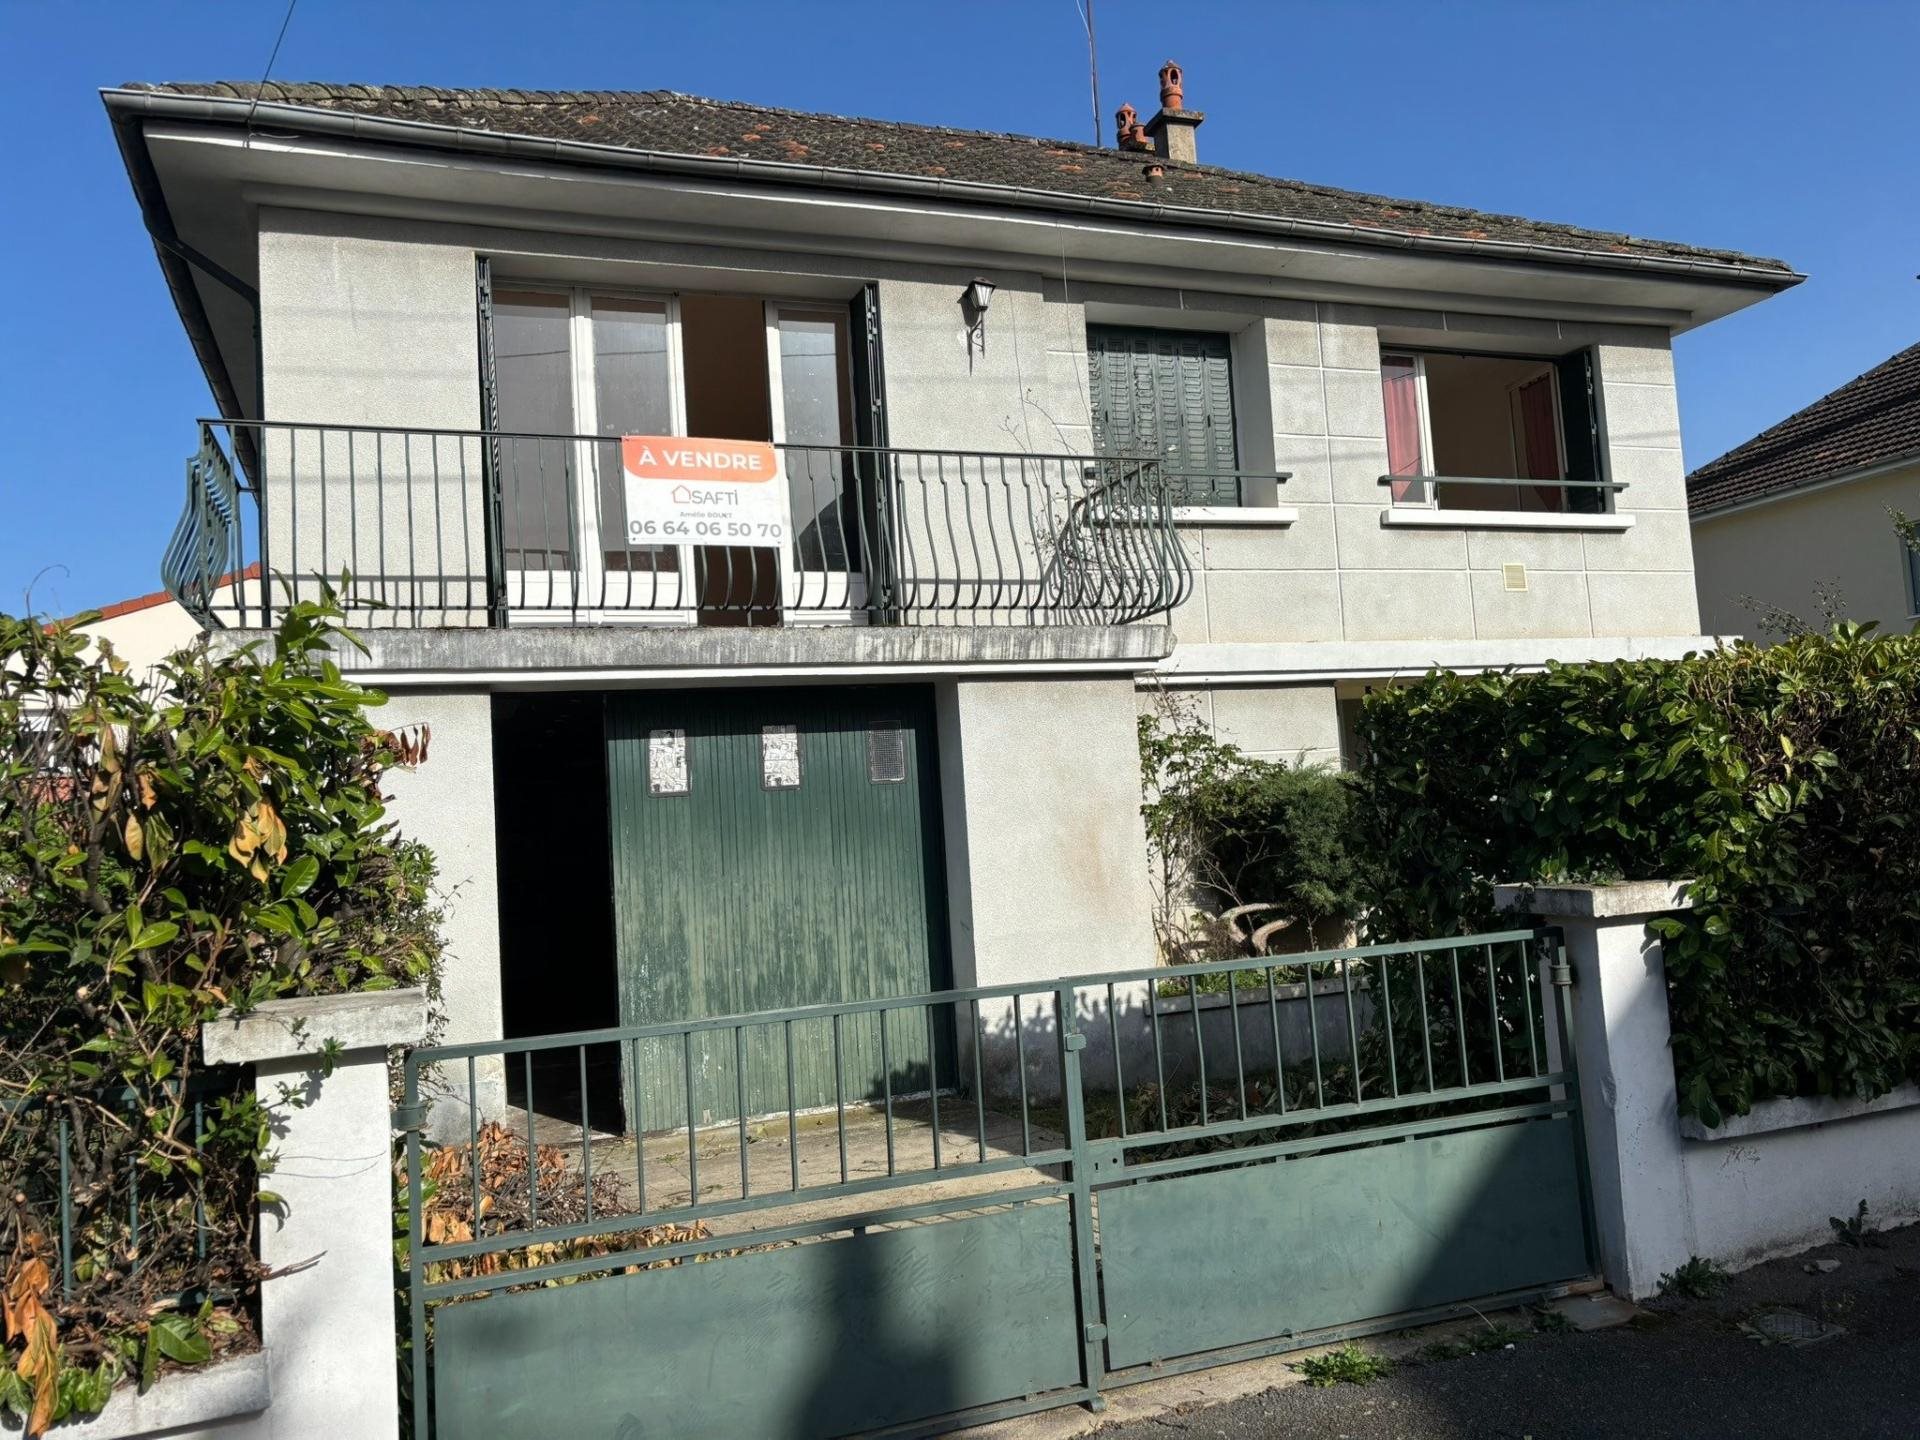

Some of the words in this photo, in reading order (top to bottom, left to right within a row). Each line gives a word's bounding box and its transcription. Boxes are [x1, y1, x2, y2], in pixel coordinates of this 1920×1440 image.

[639, 445, 657, 466] À
[662, 449, 763, 471] VENDRE
[629, 520, 657, 535] 06
[663, 520, 690, 536] 64
[695, 521, 722, 537] 06
[727, 522, 752, 537] 50
[757, 523, 782, 539] 70
